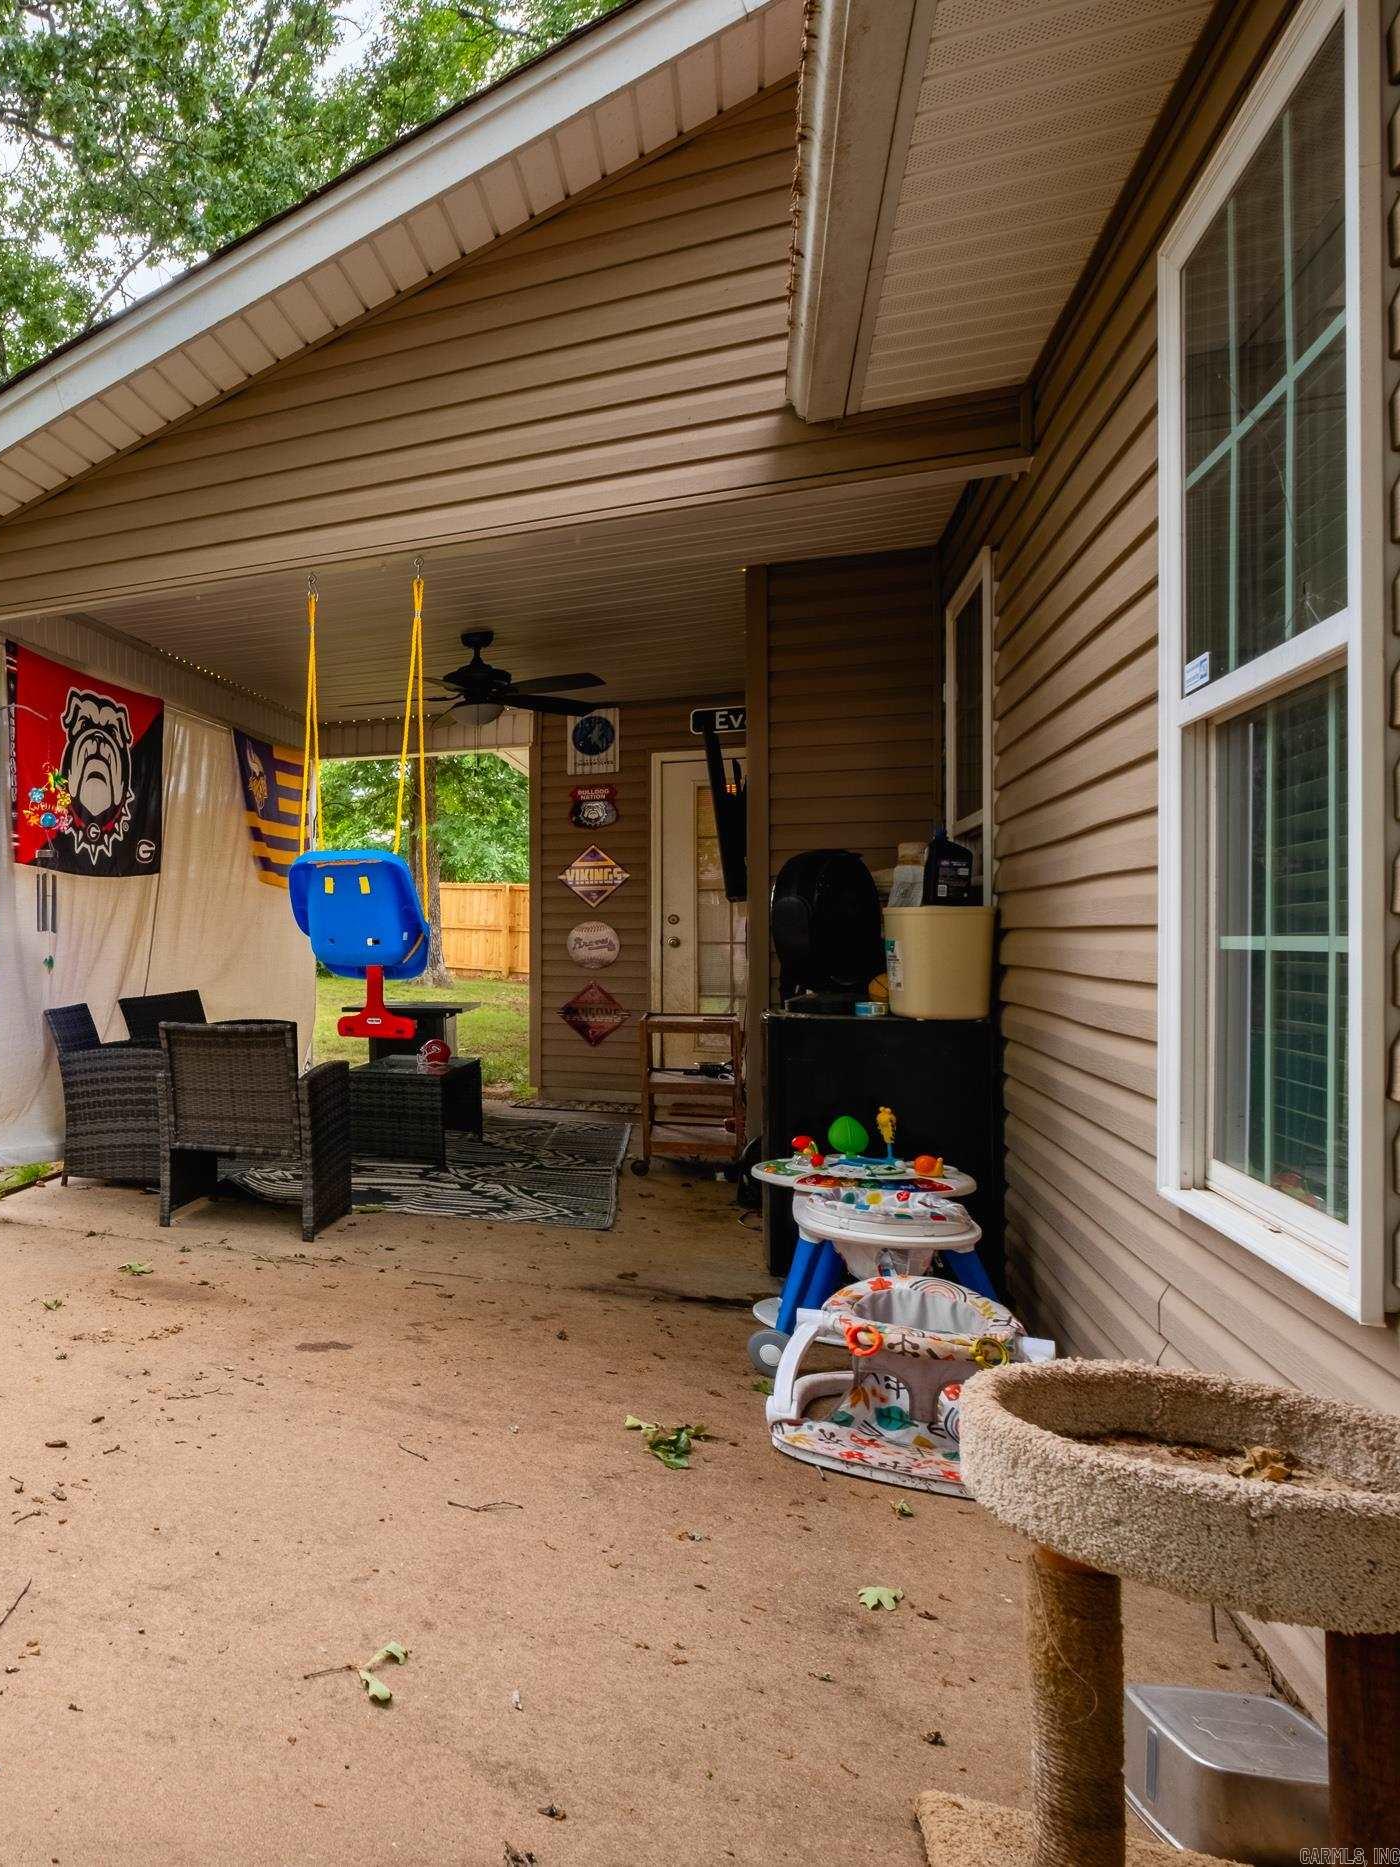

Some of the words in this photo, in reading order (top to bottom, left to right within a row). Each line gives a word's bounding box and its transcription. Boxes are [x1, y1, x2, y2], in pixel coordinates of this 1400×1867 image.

[716, 711, 749, 730] Ev
[578, 788, 609, 796] BULLDOG
[88, 824, 99, 839] G
[137, 839, 155, 863] G
[565, 867, 624, 882] VIKINGS
